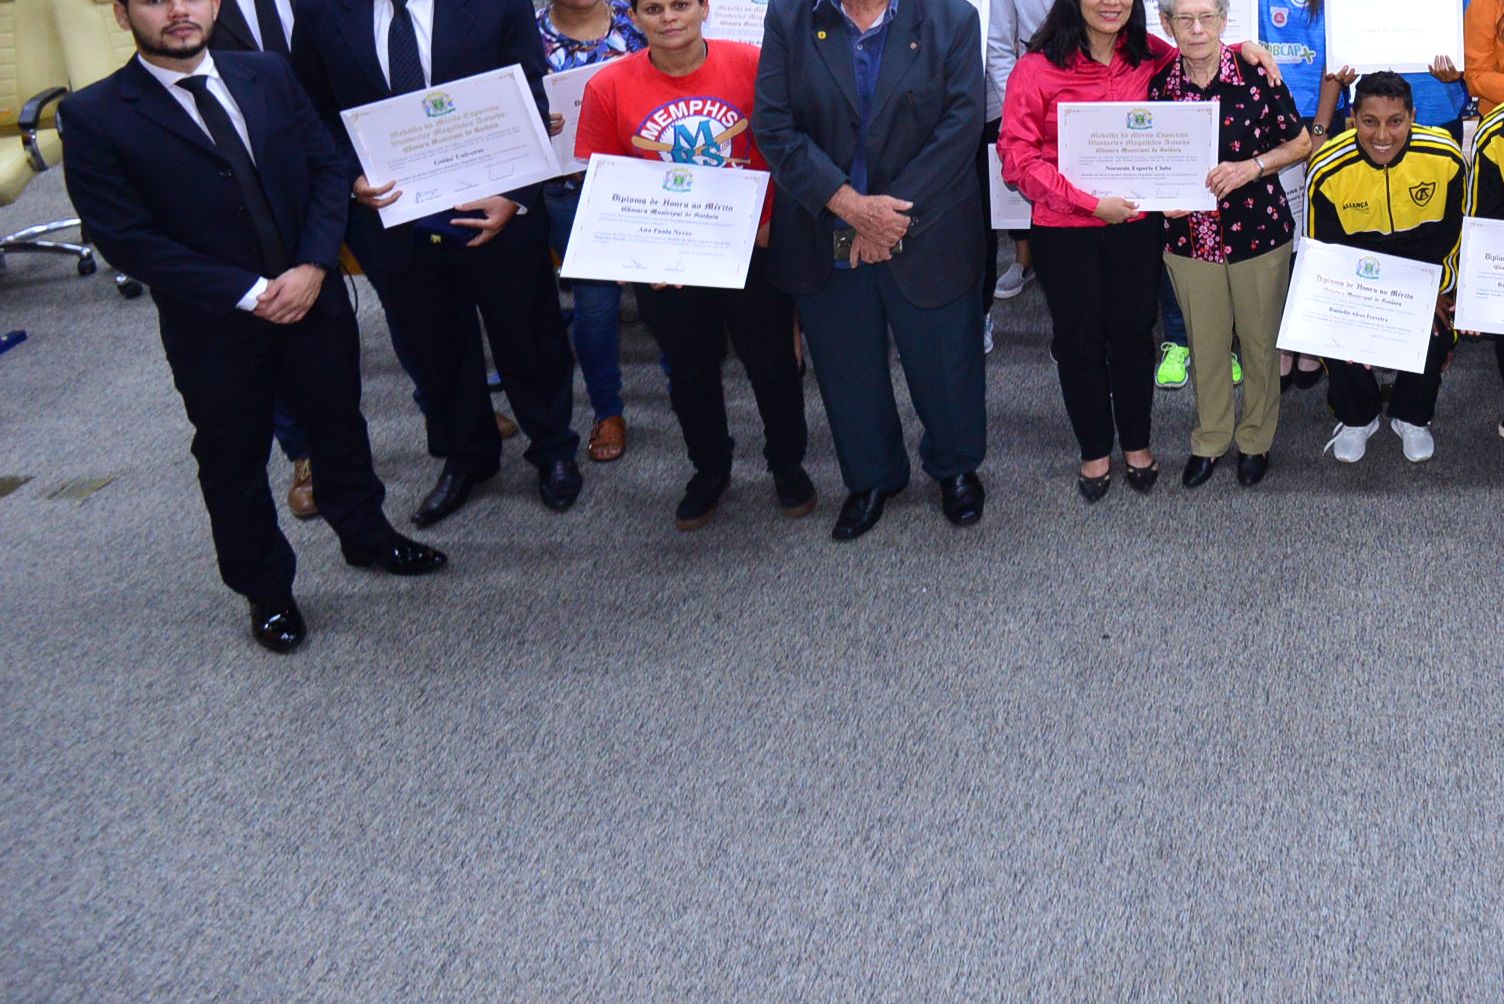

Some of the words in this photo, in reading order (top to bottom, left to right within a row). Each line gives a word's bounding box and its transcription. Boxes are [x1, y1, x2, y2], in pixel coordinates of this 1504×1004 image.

[641, 100, 738, 140] MEMPHIS
[612, 193, 646, 205] Diploma
[650, 198, 659, 206] de
[663, 198, 689, 209] Honra
[705, 203, 733, 212] Mérito
[1342, 201, 1368, 211] ALIANÇA
[651, 209, 683, 218] Municipal
[1357, 284, 1377, 294] Honra
[1391, 290, 1413, 300] Mérito
